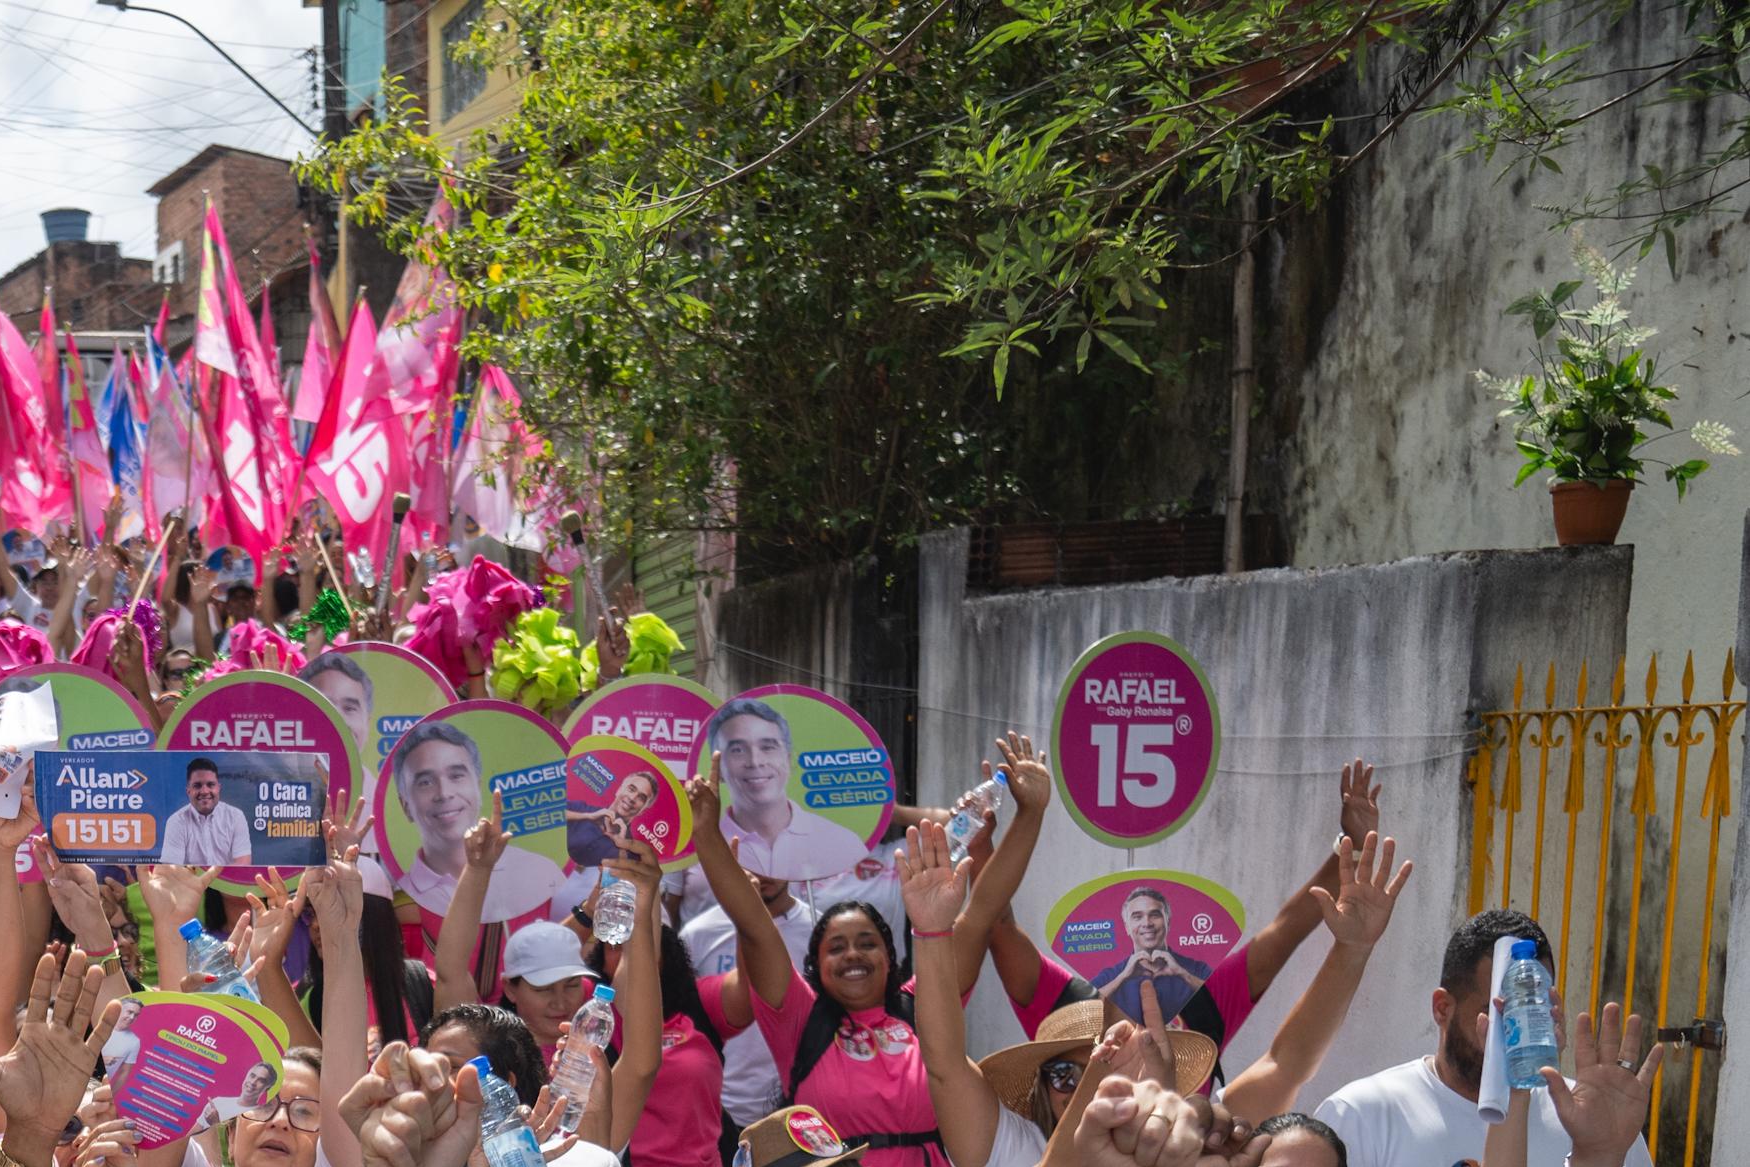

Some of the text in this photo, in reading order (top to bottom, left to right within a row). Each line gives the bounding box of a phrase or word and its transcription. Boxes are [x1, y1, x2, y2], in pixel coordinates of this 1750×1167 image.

[1084, 678, 1186, 705] RAFAEL
[1106, 705, 1132, 718] Gaby
[72, 730, 150, 751] MACEIÓ
[190, 720, 316, 747] RAFAEL
[803, 749, 882, 767] MACEIÓ
[1090, 723, 1176, 808] 15
[56, 764, 129, 789] Allan
[807, 770, 886, 786] LEVADA
[70, 788, 144, 810] Pierre
[258, 782, 308, 801] O Cara
[812, 788, 889, 806] A SÉRIO
[254, 801, 312, 818] da clínica
[65, 818, 142, 844] 15151
[267, 818, 320, 838] família!
[506, 820, 522, 834] A
[636, 823, 666, 855] RAFAEL
[1067, 921, 1112, 933] MACEIÓ
[1065, 932, 1112, 943] LEVADA
[1178, 934, 1228, 947] RAFAEL
[1066, 942, 1114, 953] A SÉRIO
[176, 1024, 218, 1050] RAFAEL
